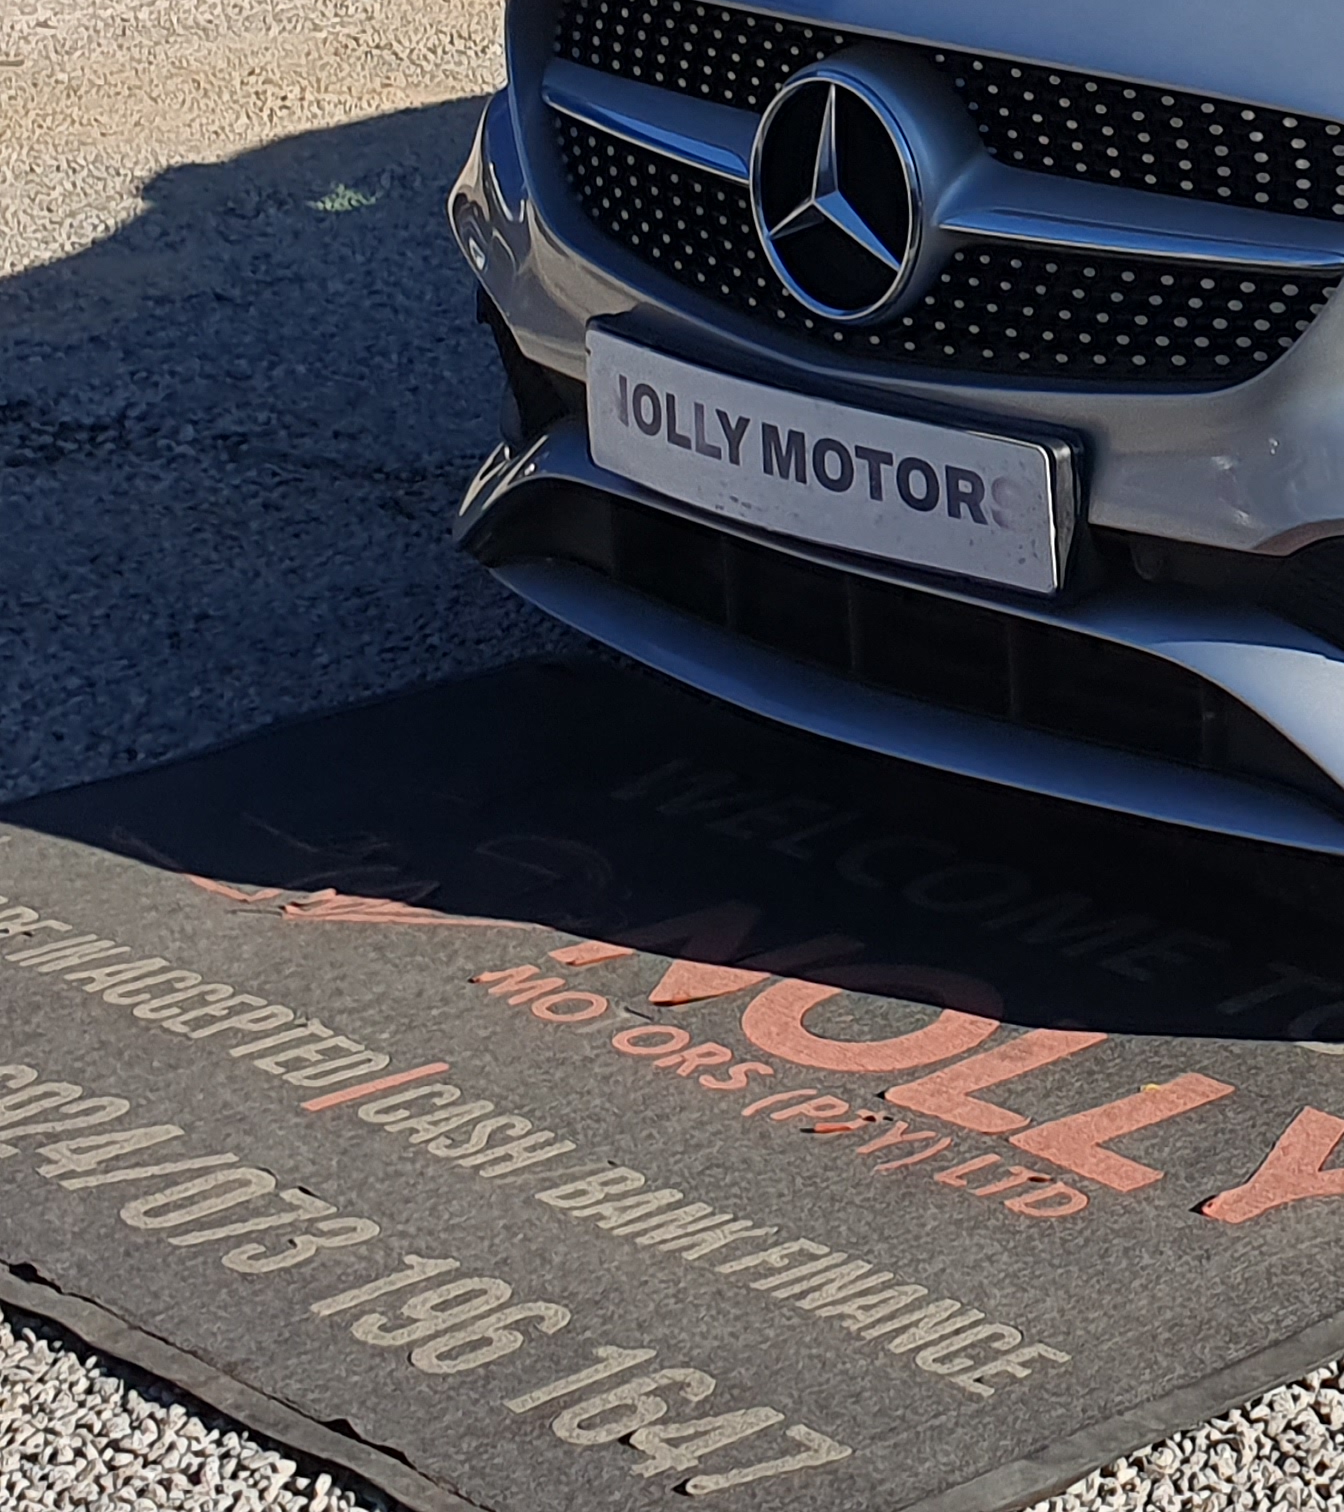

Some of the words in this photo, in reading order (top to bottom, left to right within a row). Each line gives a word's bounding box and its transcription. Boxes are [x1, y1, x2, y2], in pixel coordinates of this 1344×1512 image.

[611, 757, 1230, 982] WELCOME
[474, 964, 774, 1091] MOORS
[933, 1153, 1090, 1218] LTD
[310, 1254, 570, 1375] 196
[506, 1345, 853, 1497] 1647
[535, 1167, 778, 1261] BANK
[714, 1239, 1073, 1399] FINANCE
